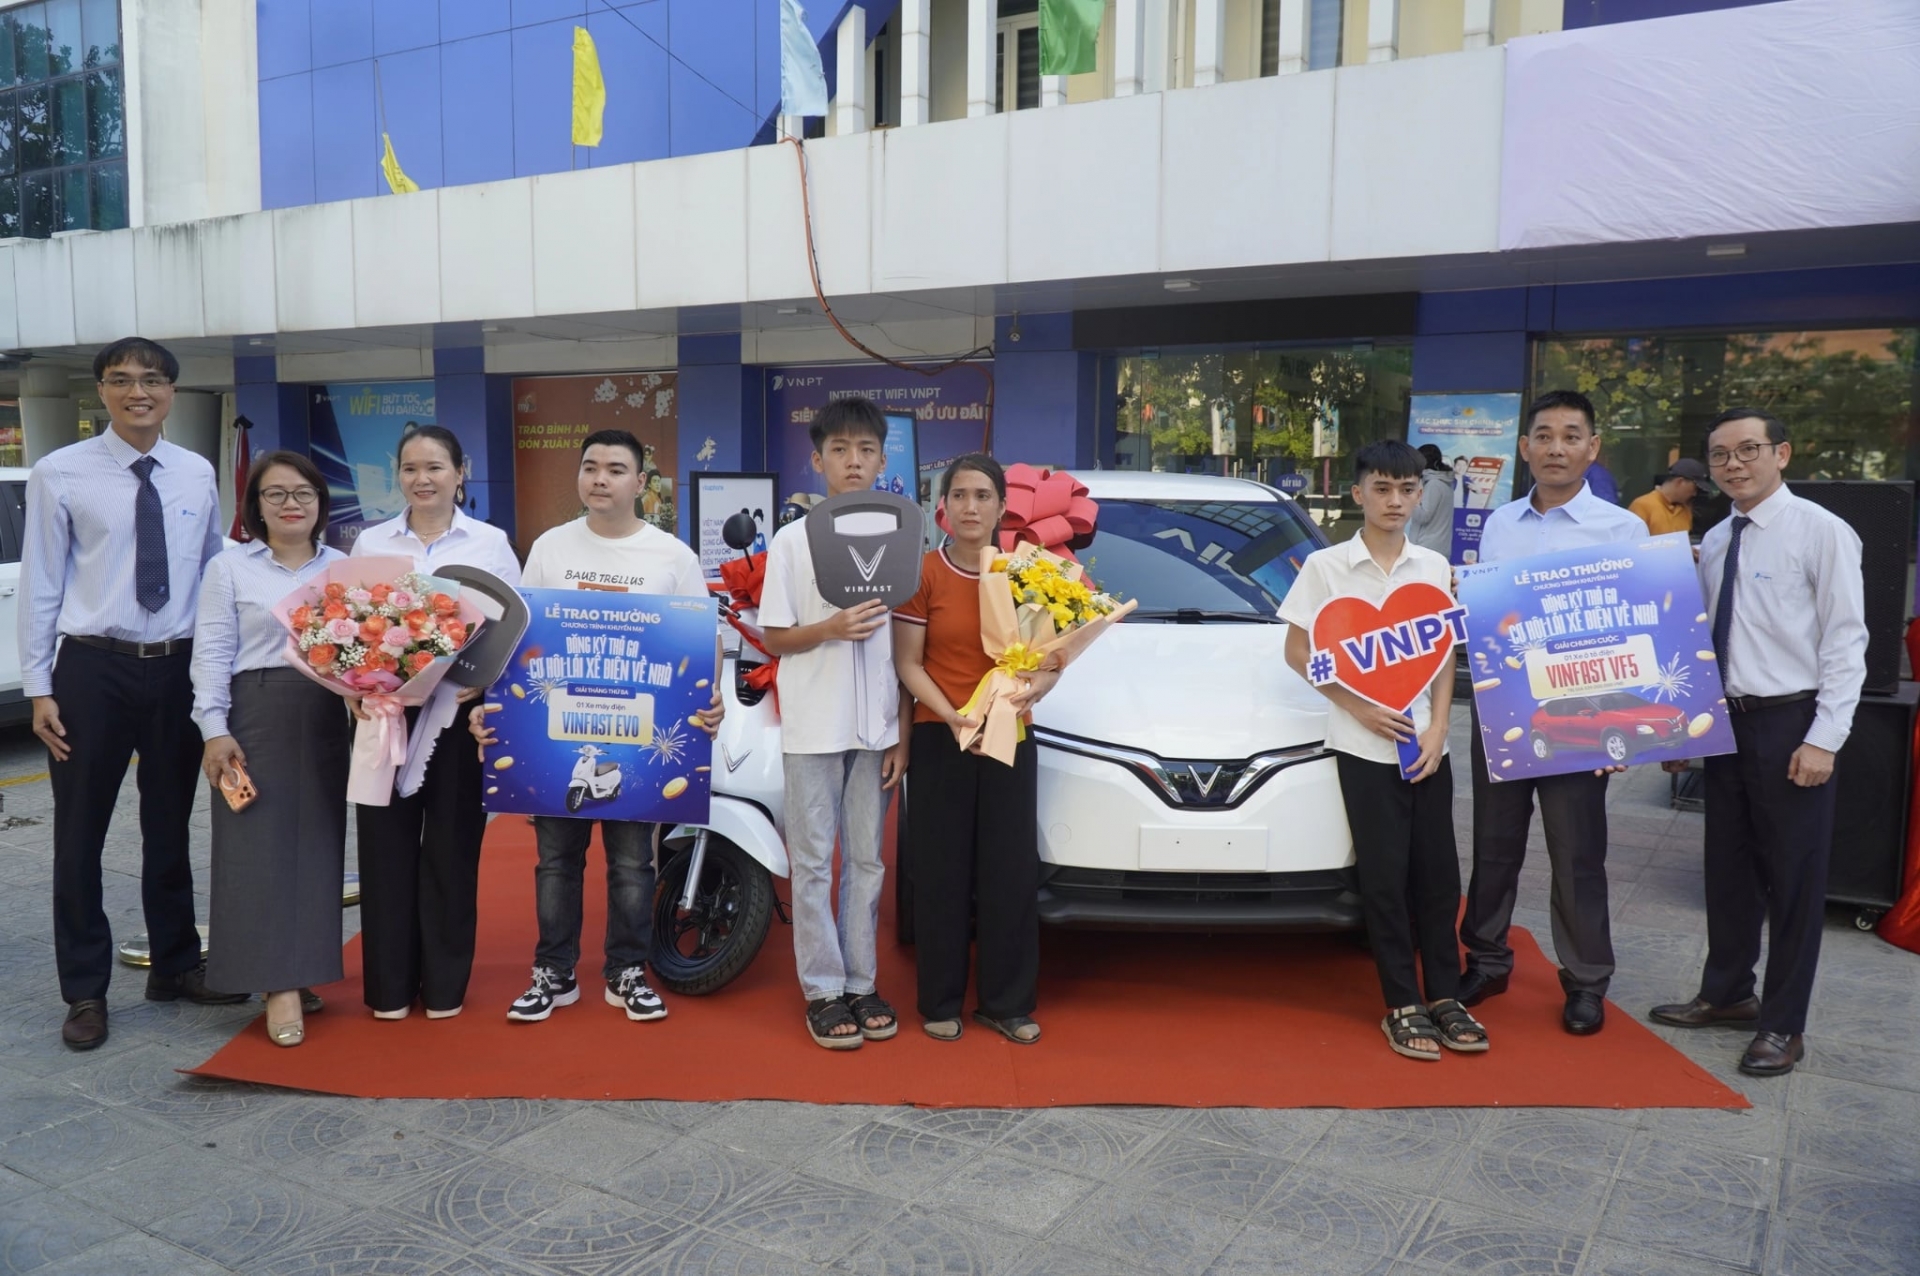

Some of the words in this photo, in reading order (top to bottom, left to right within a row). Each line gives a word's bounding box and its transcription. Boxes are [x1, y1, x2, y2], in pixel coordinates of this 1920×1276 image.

[787, 376, 823, 387] VNPT
[884, 388, 907, 400] WIFI
[910, 387, 941, 399] VNPT
[916, 401, 933, 420] NỔ
[937, 405, 957, 420] ƯU
[960, 402, 983, 420] ĐÃI
[518, 425, 544, 435] TRAO
[547, 422, 571, 434] BÌNH
[575, 424, 589, 434] AN
[518, 437, 540, 449] ĐÓN
[543, 436, 570, 449] XUÂN
[564, 569, 597, 582] BAUB
[1471, 566, 1499, 577] VNPT
[1514, 569, 1530, 586] LỄ
[1531, 567, 1571, 583] TRAO
[1571, 557, 1634, 577] THƯỞNG
[844, 585, 892, 593] VINFAST
[1568, 587, 1583, 609] KÝ
[1604, 587, 1618, 605] GA
[545, 603, 560, 618] LỄ
[562, 607, 600, 620] TRAO
[602, 608, 661, 624] THƯỞNG
[592, 634, 607, 655] KÝ
[626, 640, 639, 658] GA
[1570, 638, 1597, 648] CHUNG
[1598, 634, 1620, 644] CUỘC
[1584, 651, 1589, 659] ô
[1599, 649, 1615, 657] điện
[1545, 657, 1607, 689] VINFAST
[1608, 653, 1639, 680] VF5
[595, 703, 610, 711] máy
[611, 703, 626, 711] điện
[562, 711, 613, 737] VINFAST
[615, 714, 640, 738] EVO
